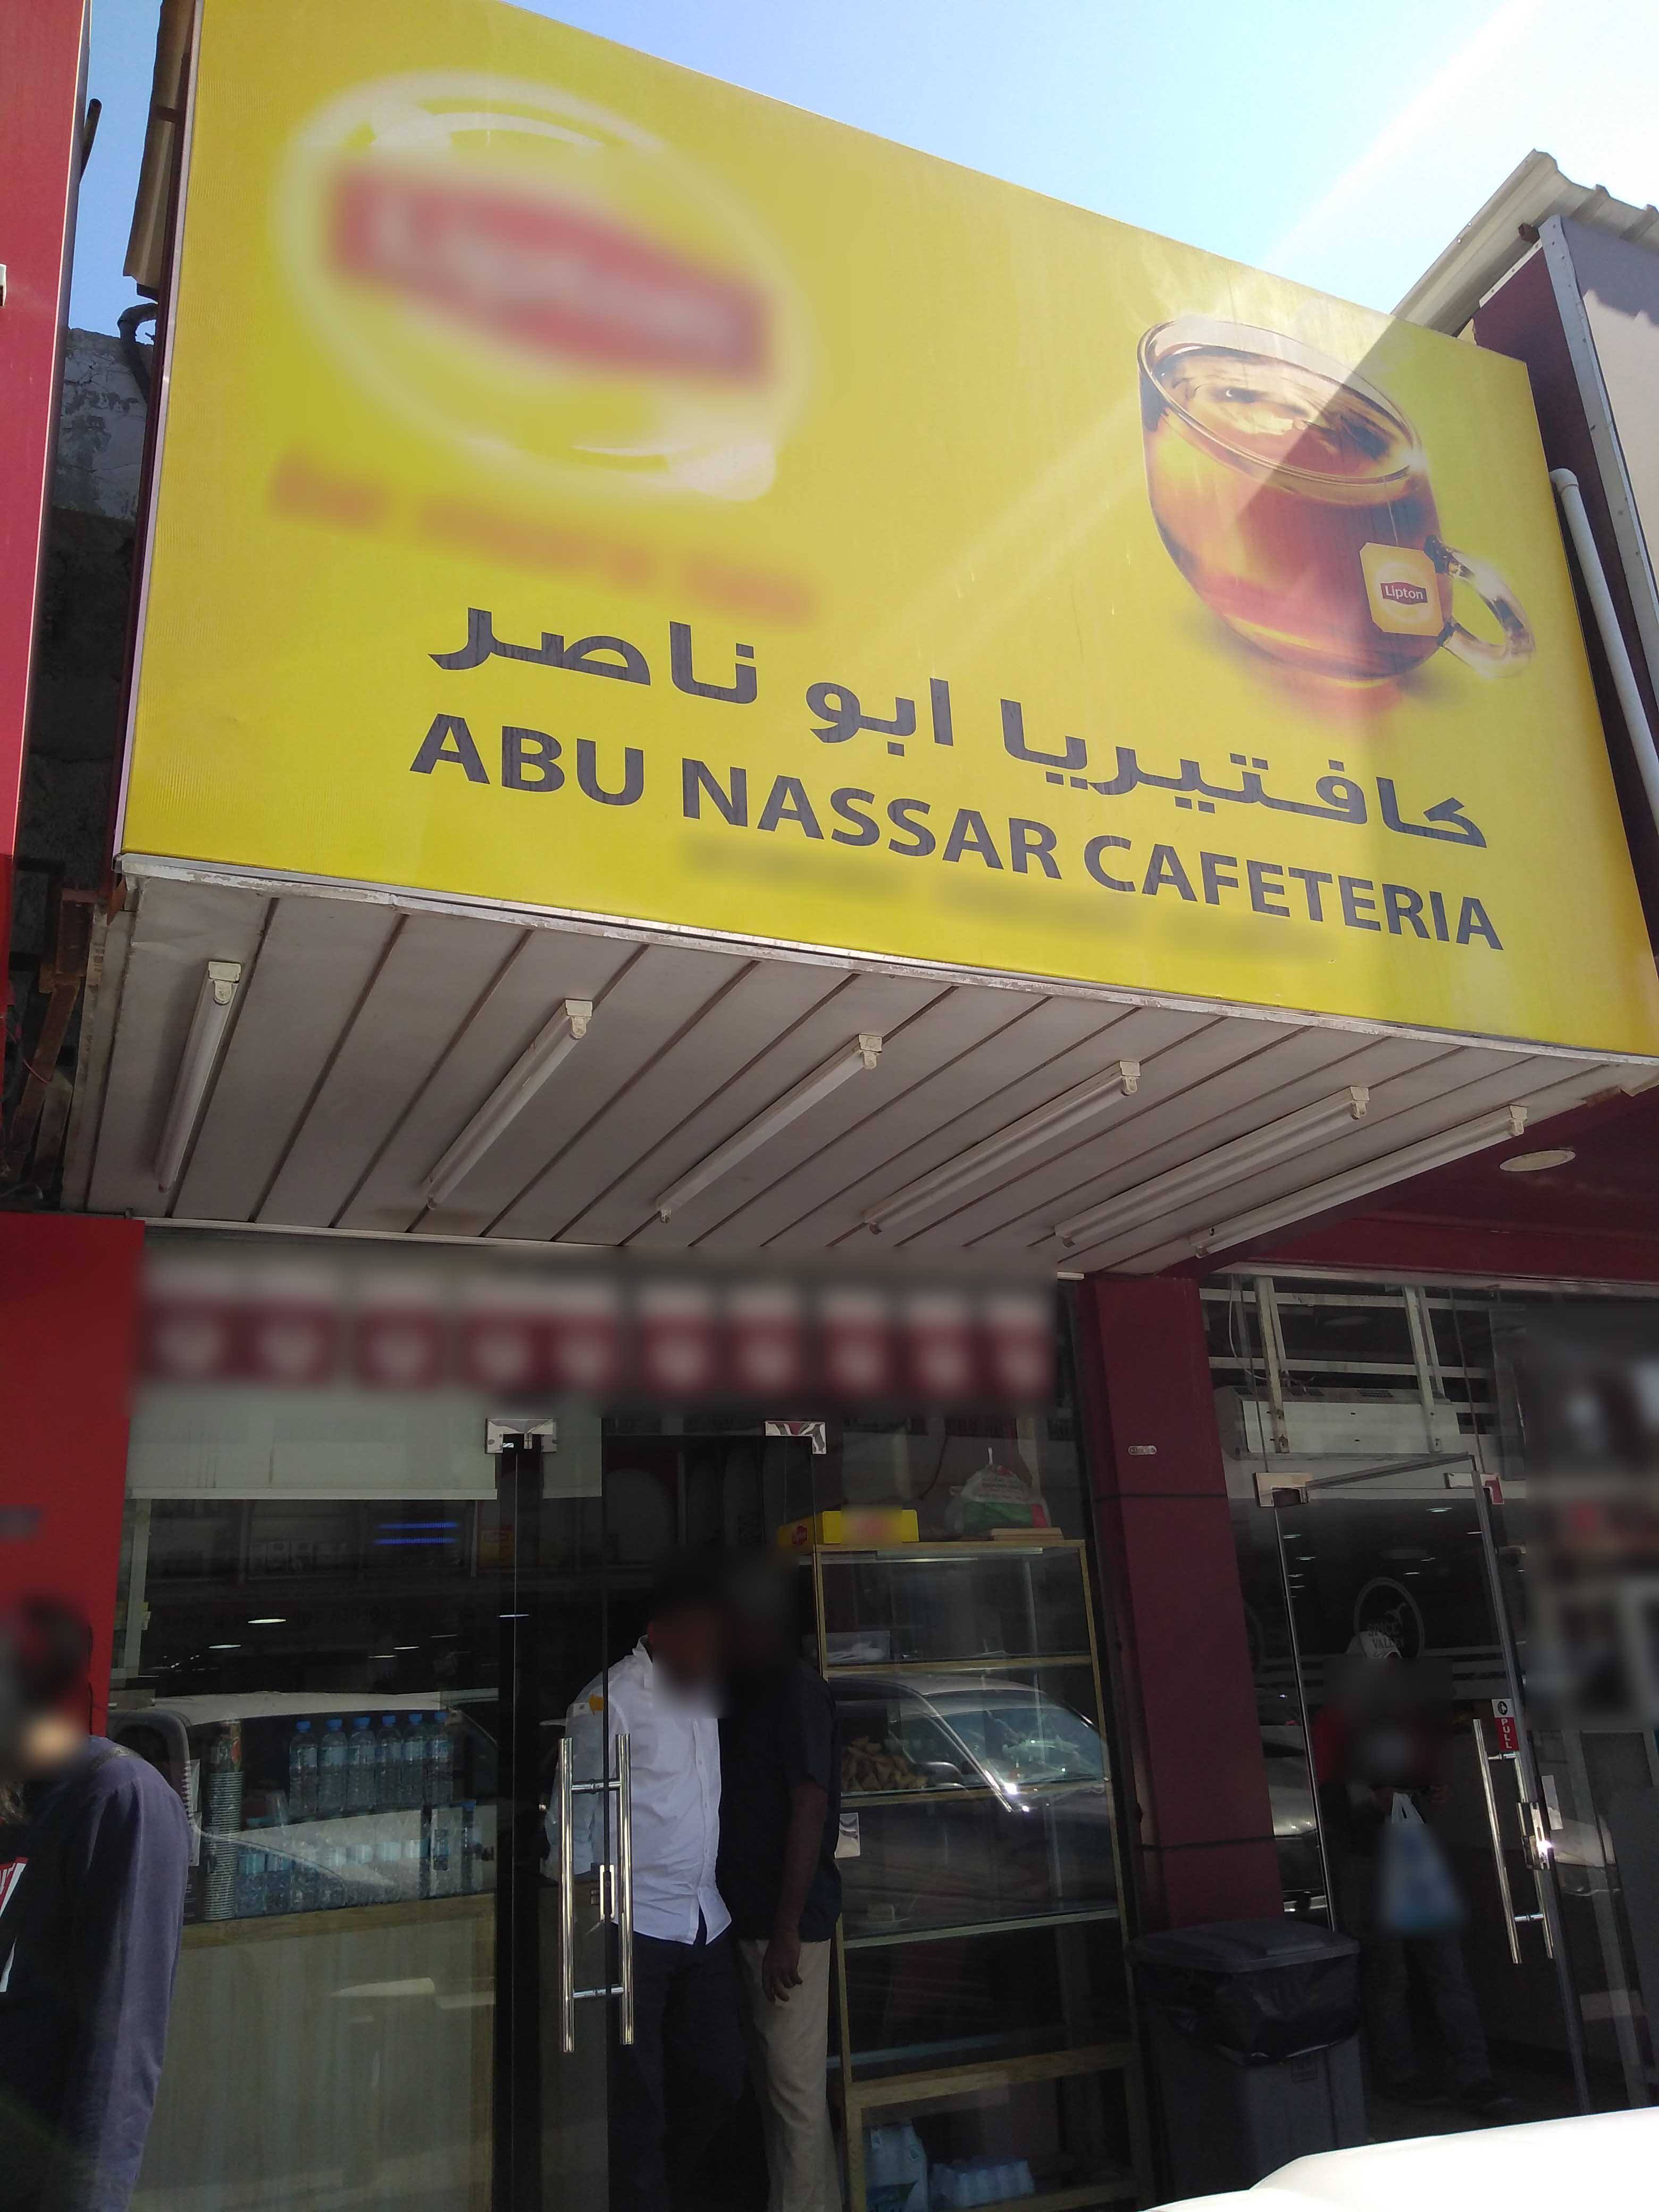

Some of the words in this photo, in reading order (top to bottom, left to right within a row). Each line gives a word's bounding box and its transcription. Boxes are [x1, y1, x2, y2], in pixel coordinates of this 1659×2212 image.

[1384, 585, 1424, 600] Lipton
[428, 607, 758, 704] ناصر
[806, 677, 953, 756] ابو
[1000, 699, 1487, 848] كافتيريا
[410, 713, 645, 806] ABU
[682, 758, 1062, 880] NASSAR
[1083, 835, 1504, 952] CAFETERIA
[1501, 1718, 1512, 1749] PULL
